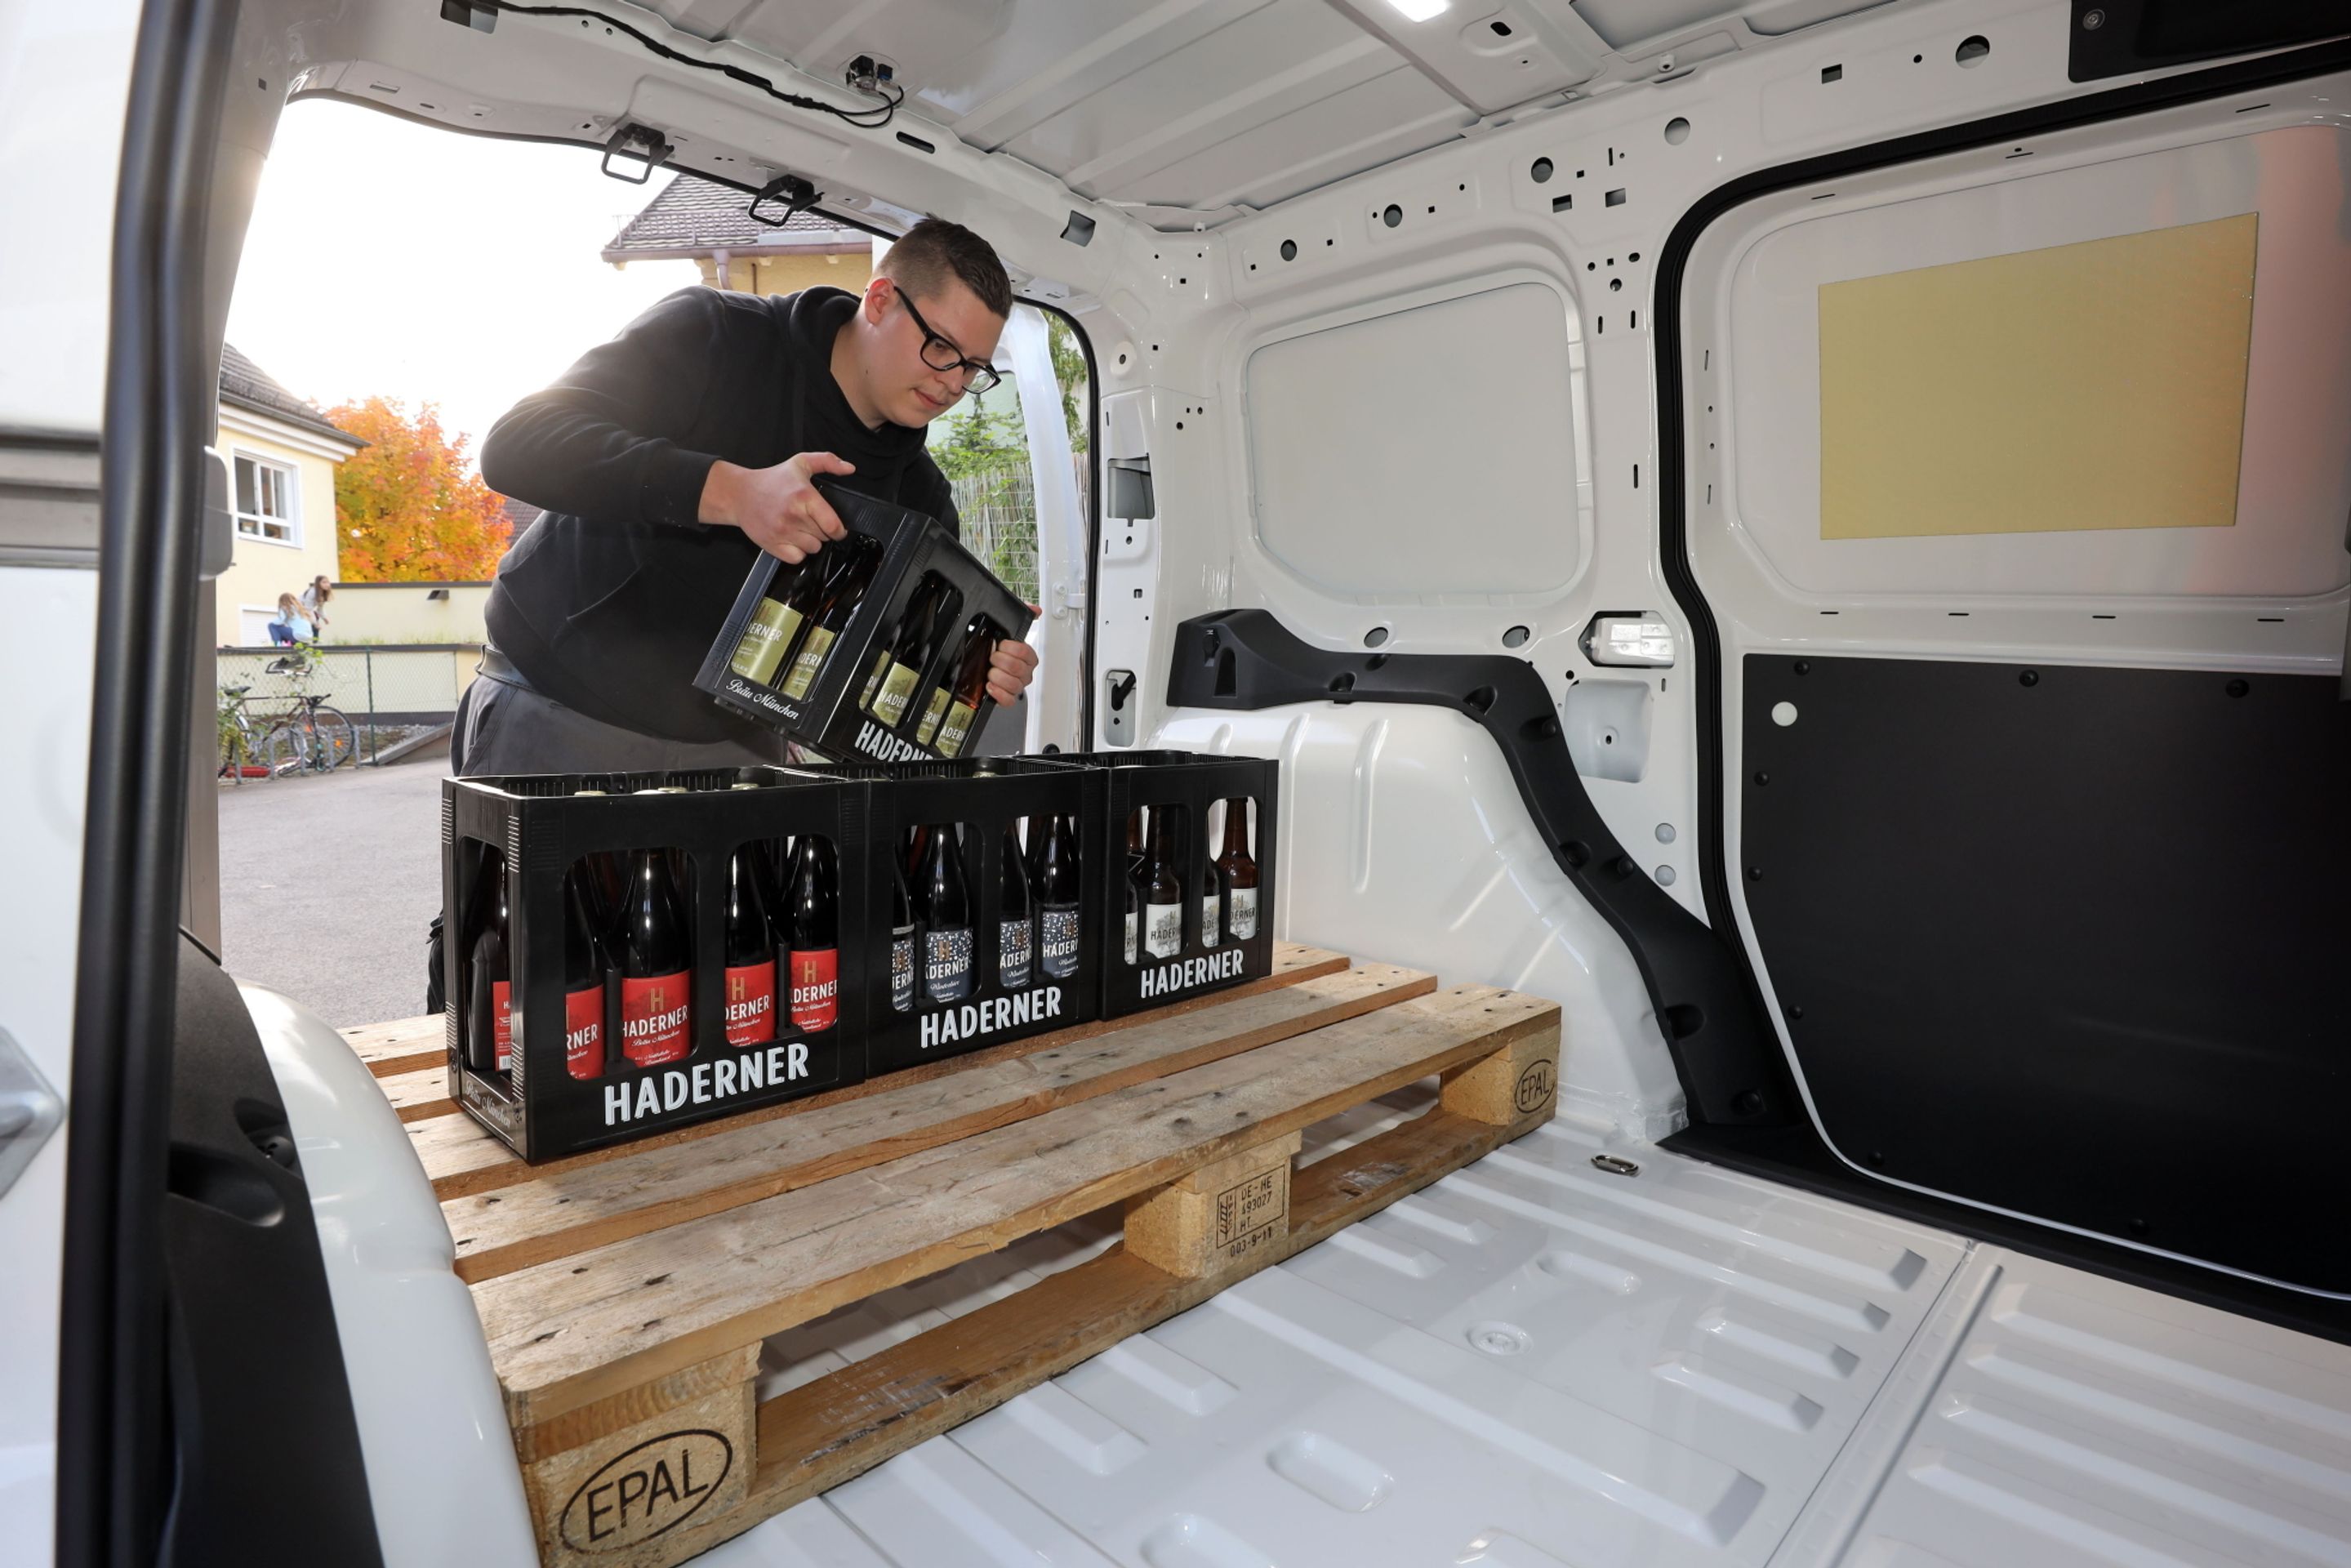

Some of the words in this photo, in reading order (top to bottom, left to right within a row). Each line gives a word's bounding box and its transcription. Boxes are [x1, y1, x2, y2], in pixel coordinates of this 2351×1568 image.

[726, 679, 754, 699] Bräu
[753, 693, 799, 720] München
[731, 977, 746, 1001] H
[804, 960, 817, 983] H
[1140, 948, 1245, 999] HADERNER
[650, 987, 665, 1013] H
[790, 980, 838, 1004] DERNE
[919, 986, 1062, 1049] HADERNER
[603, 1043, 809, 1126] HADERNER
[1521, 1069, 1550, 1106] EPAL
[1240, 1175, 1273, 1201] DE-HE
[586, 1449, 710, 1543] EPAL
